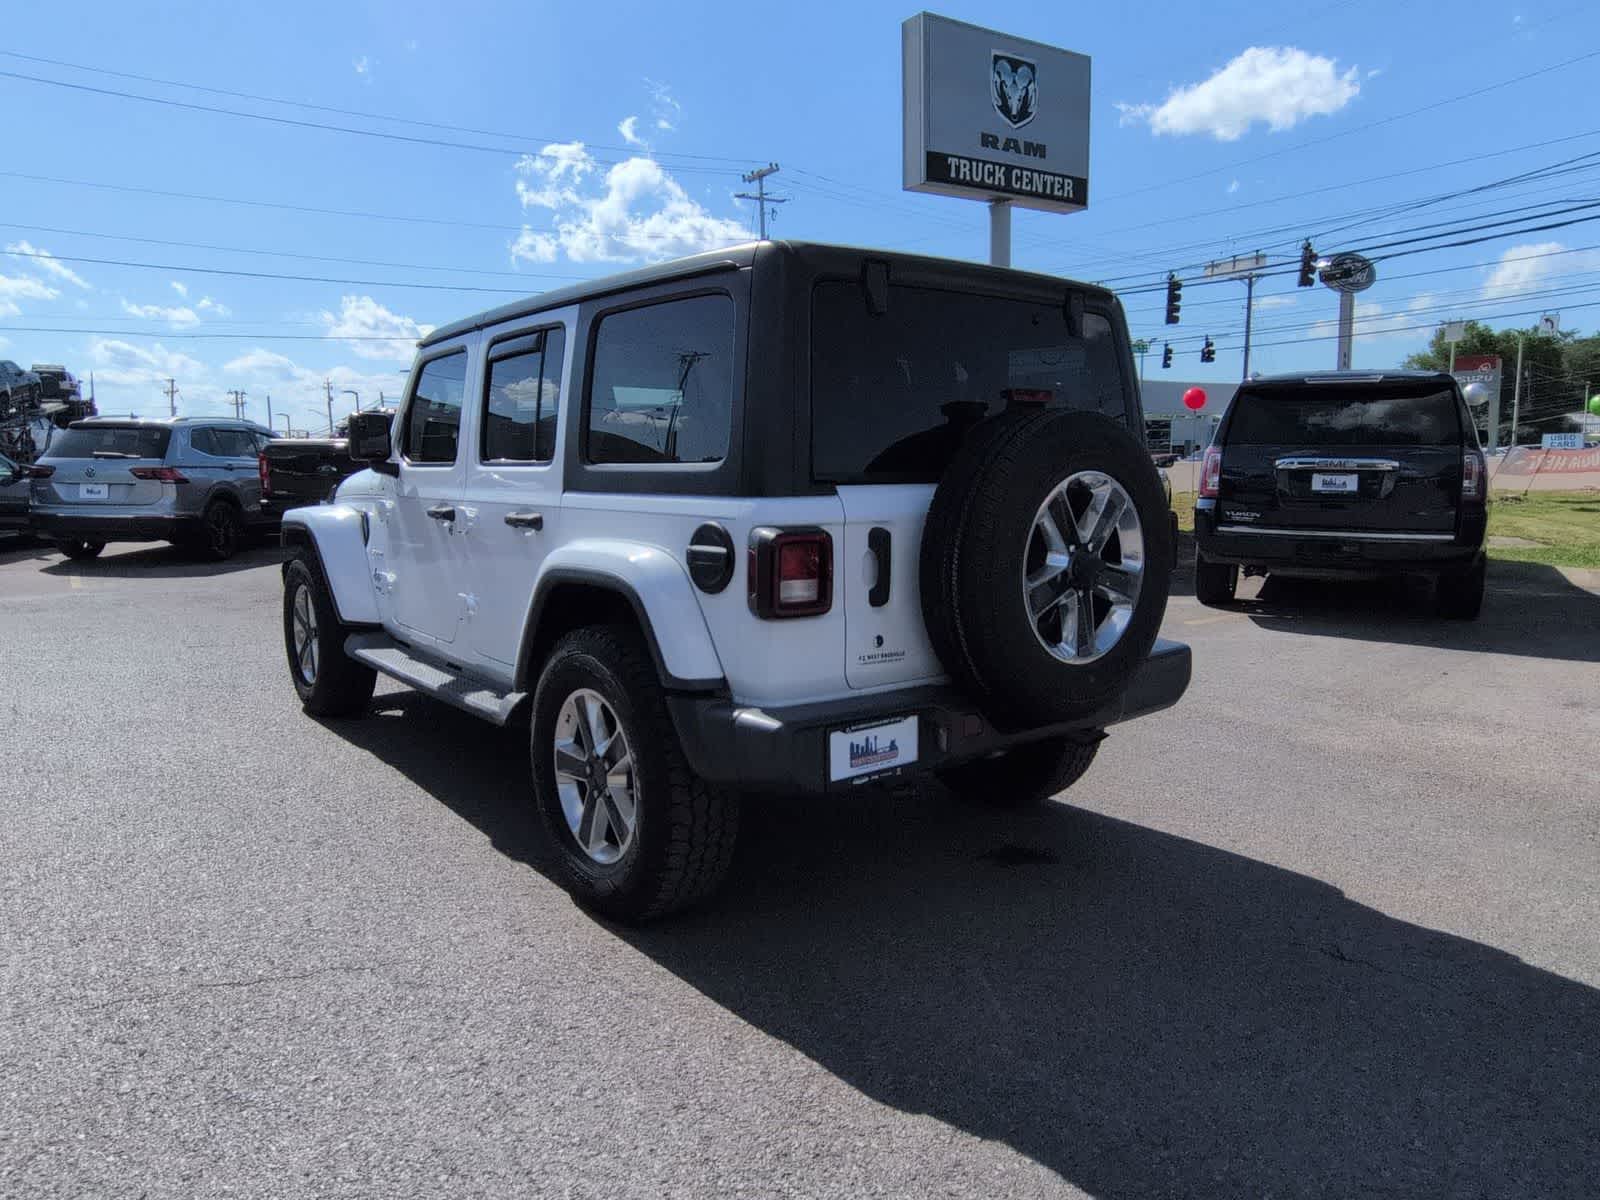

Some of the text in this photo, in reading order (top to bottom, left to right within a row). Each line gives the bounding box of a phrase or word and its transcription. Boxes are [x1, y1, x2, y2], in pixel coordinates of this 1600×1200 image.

[980, 132, 1047, 159] RAM
[947, 157, 1074, 198] TRUCK CENTER
